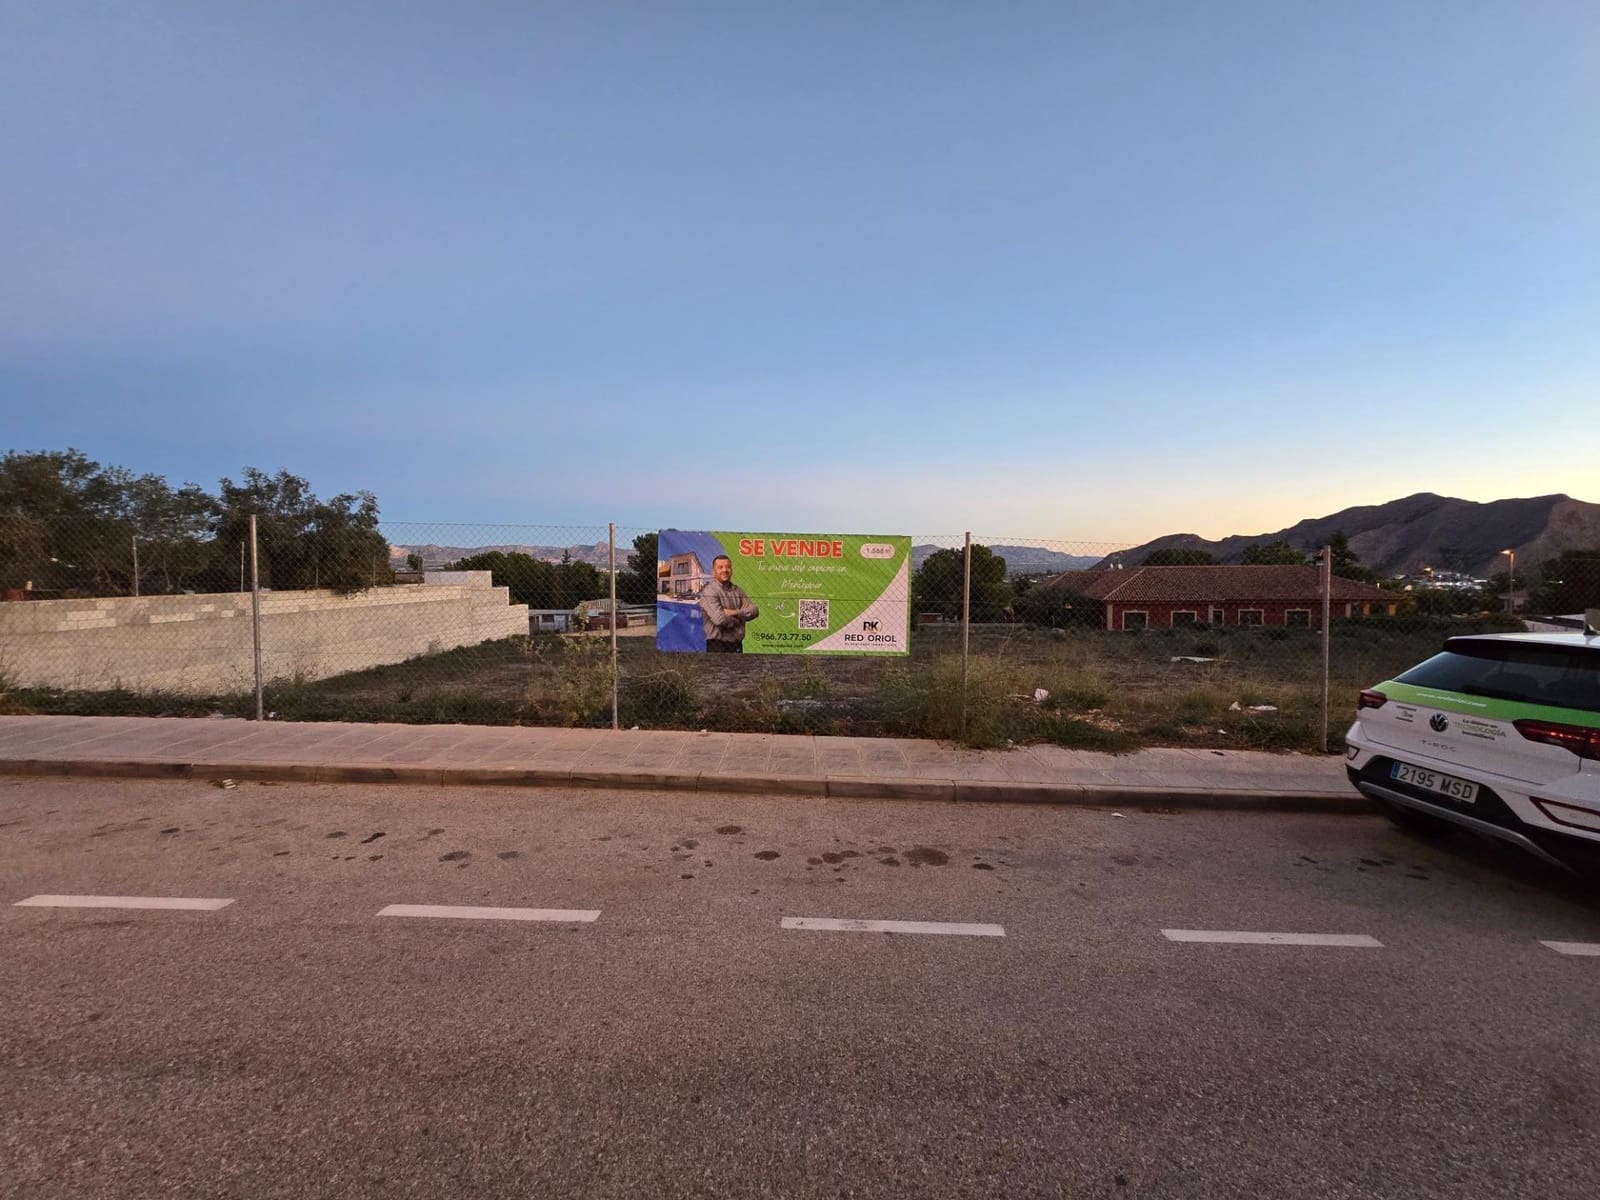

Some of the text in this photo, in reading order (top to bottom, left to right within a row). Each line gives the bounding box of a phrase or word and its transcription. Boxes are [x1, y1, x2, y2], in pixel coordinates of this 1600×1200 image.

[739, 539, 844, 559] SE VENDE
[760, 632, 812, 642] 966.73.77.50
[844, 634, 897, 643] RED ORIOL
[1399, 767, 1474, 800] 2195 MSD
